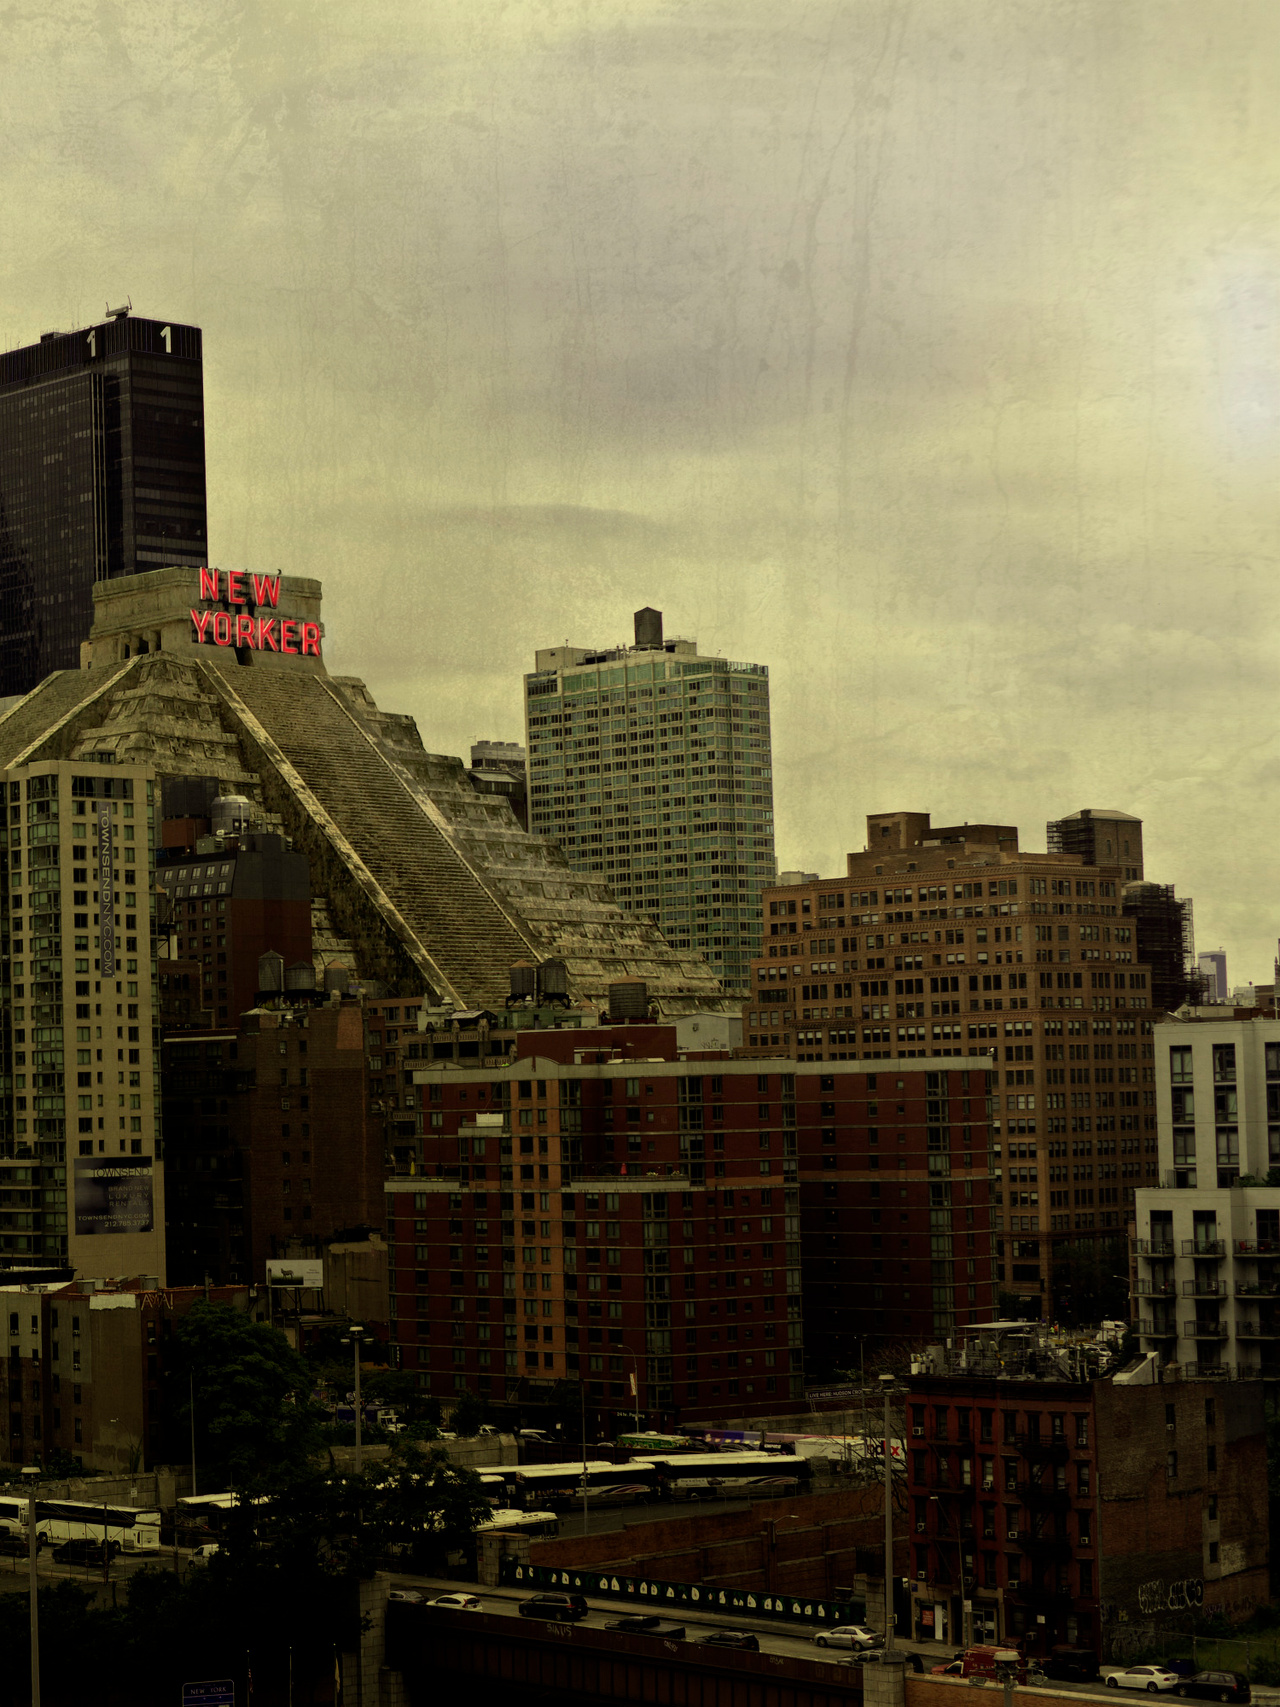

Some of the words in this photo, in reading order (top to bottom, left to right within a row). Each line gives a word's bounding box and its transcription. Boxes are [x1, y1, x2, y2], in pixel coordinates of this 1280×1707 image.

[86, 329, 96, 358] 1
[160, 326, 172, 354] 1
[199, 567, 281, 608] NEW
[190, 608, 321, 657] YORKER
[100, 806, 113, 975] TOWNSENDNYC.COM
[93, 1167, 150, 1178] TOWNSEND
[108, 1192, 149, 1200] LUXURY
[78, 1213, 150, 1221] TOWNSENDNYC.COM
